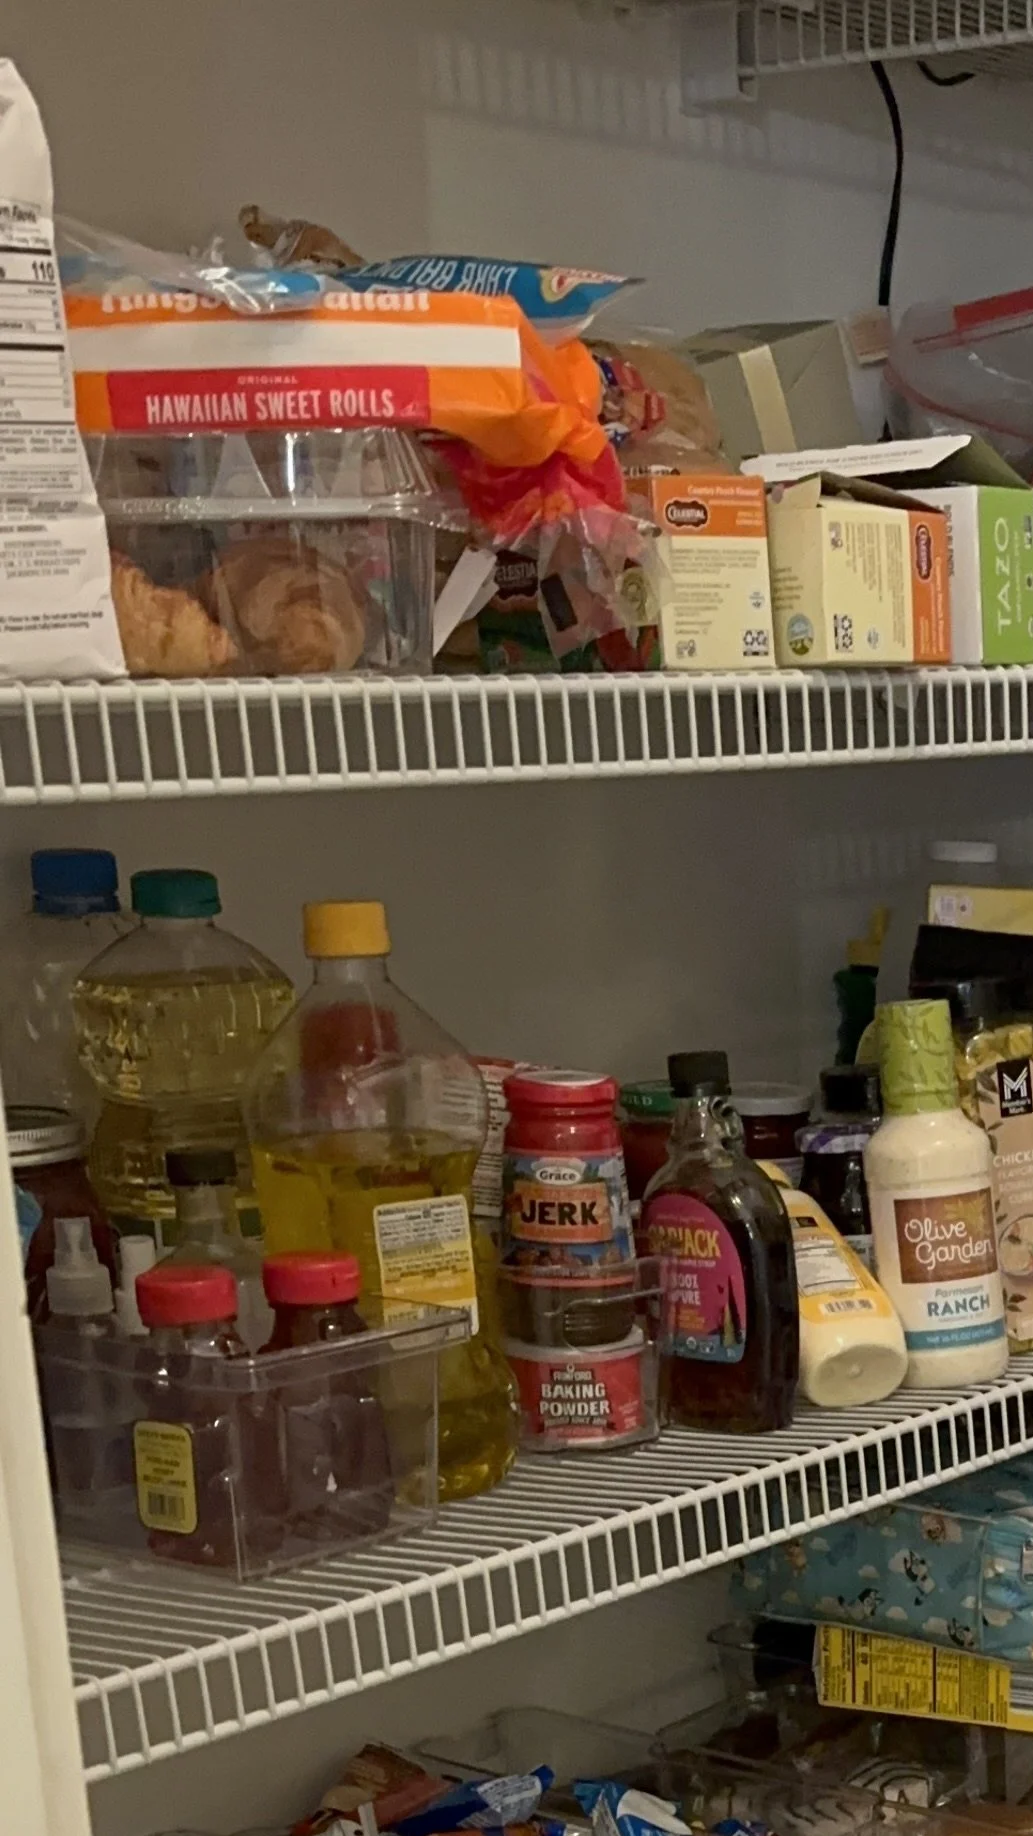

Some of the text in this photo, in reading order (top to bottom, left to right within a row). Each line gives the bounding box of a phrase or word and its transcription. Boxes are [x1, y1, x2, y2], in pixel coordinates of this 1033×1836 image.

[237, 375, 298, 385] ORIGINAL
[146, 388, 395, 424] HAWAIIAN SWEET ROLLS
[994, 516, 1012, 637] TAZO
[540, 1169, 576, 1182] Grace
[521, 1201, 600, 1227] JERK
[904, 1217, 968, 1243] Olive
[915, 1237, 994, 1270] Garden
[927, 1295, 990, 1318] RANCH
[541, 1382, 606, 1398] BAKING
[539, 1400, 610, 1417] POWDER
